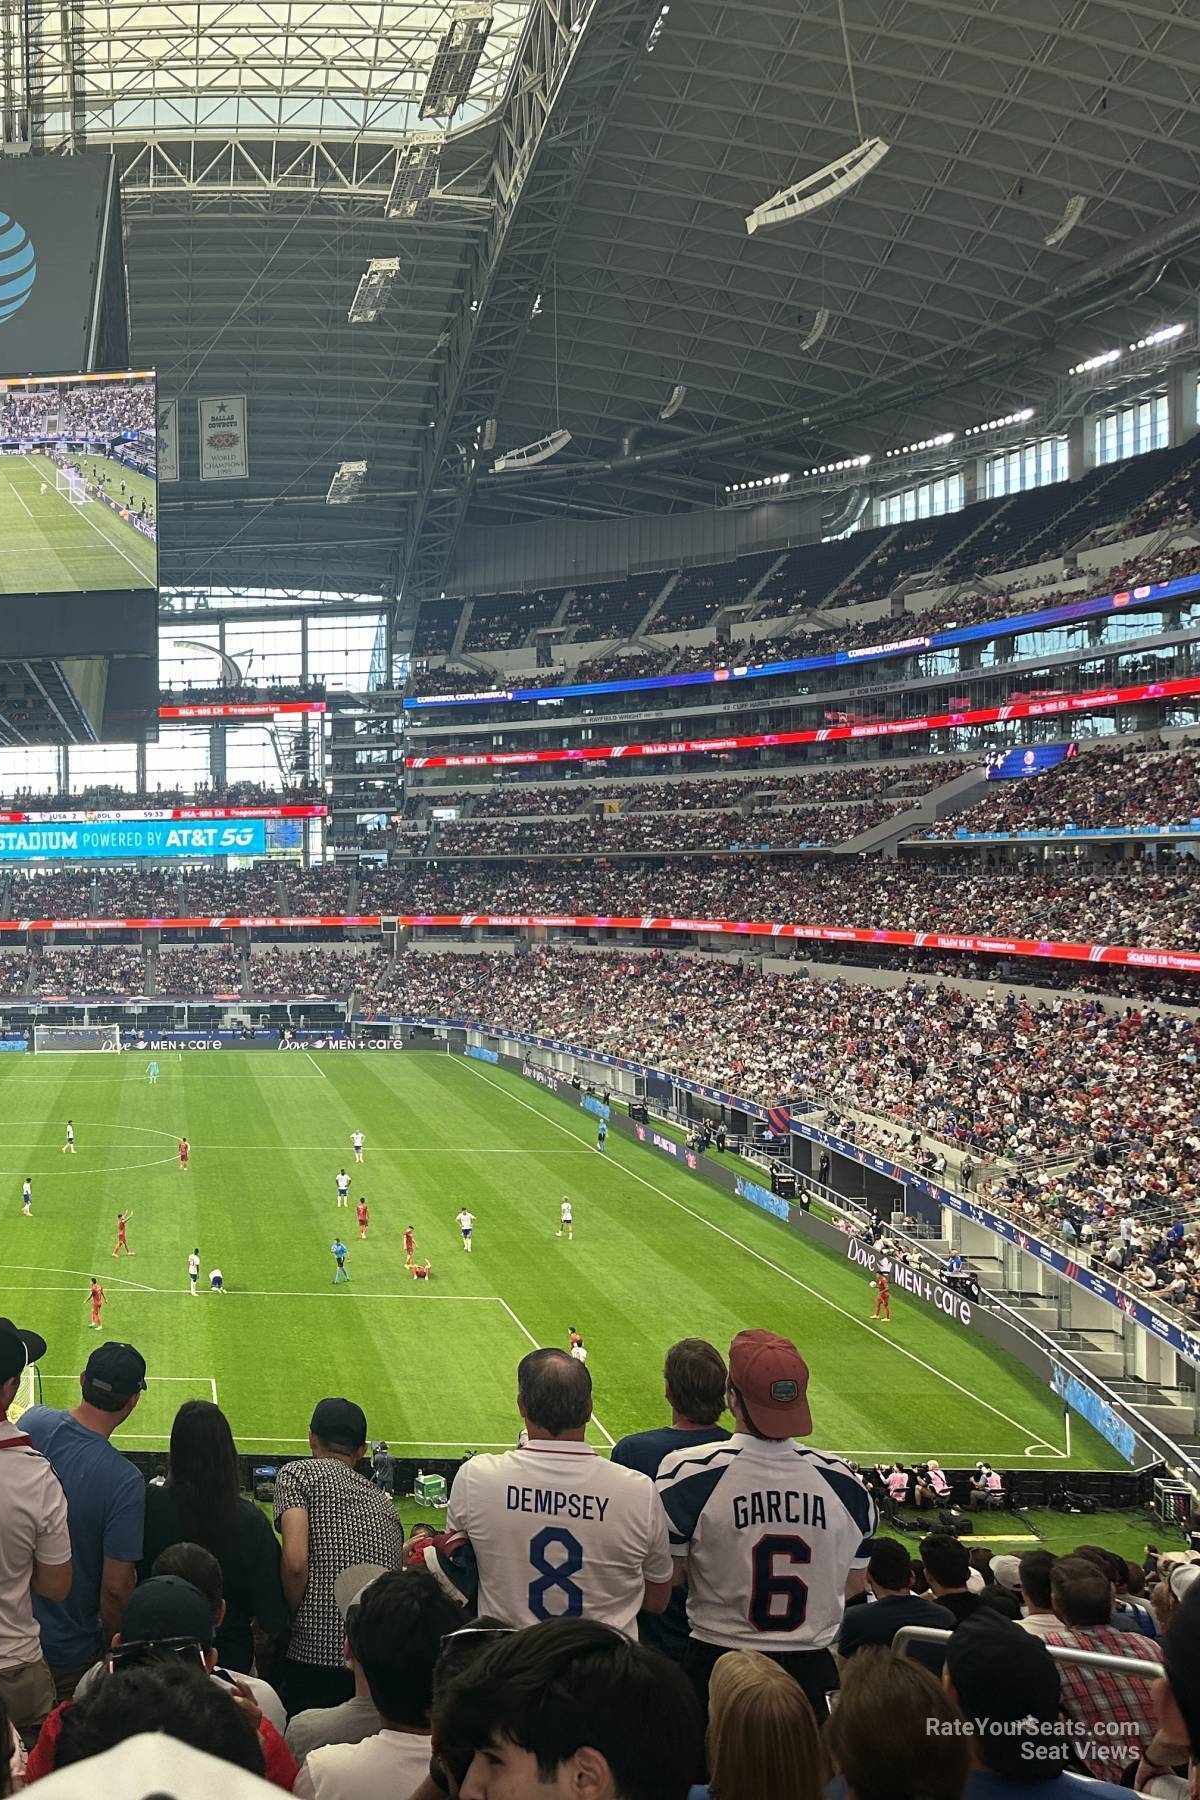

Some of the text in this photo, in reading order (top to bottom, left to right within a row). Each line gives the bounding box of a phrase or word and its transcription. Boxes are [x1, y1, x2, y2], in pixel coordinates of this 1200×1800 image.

[143, 810, 164, 818] 59:33
[82, 833, 142, 848] POWERED
[147, 831, 162, 847] BY
[165, 828, 218, 848] AT&T
[218, 827, 255, 847] 5G
[151, 1040, 176, 1050] MEN
[188, 1039, 222, 1050] care
[278, 1039, 309, 1050] Dove
[329, 1040, 355, 1050] MEN
[367, 1039, 403, 1050] care
[847, 1237, 875, 1272] Dove
[894, 1263, 922, 1297] MEN
[933, 1285, 971, 1325] care
[506, 1485, 609, 1522] DEMPSEY
[732, 1490, 827, 1530] GARCIA
[528, 1526, 583, 1622] 8
[749, 1533, 812, 1632] 6
